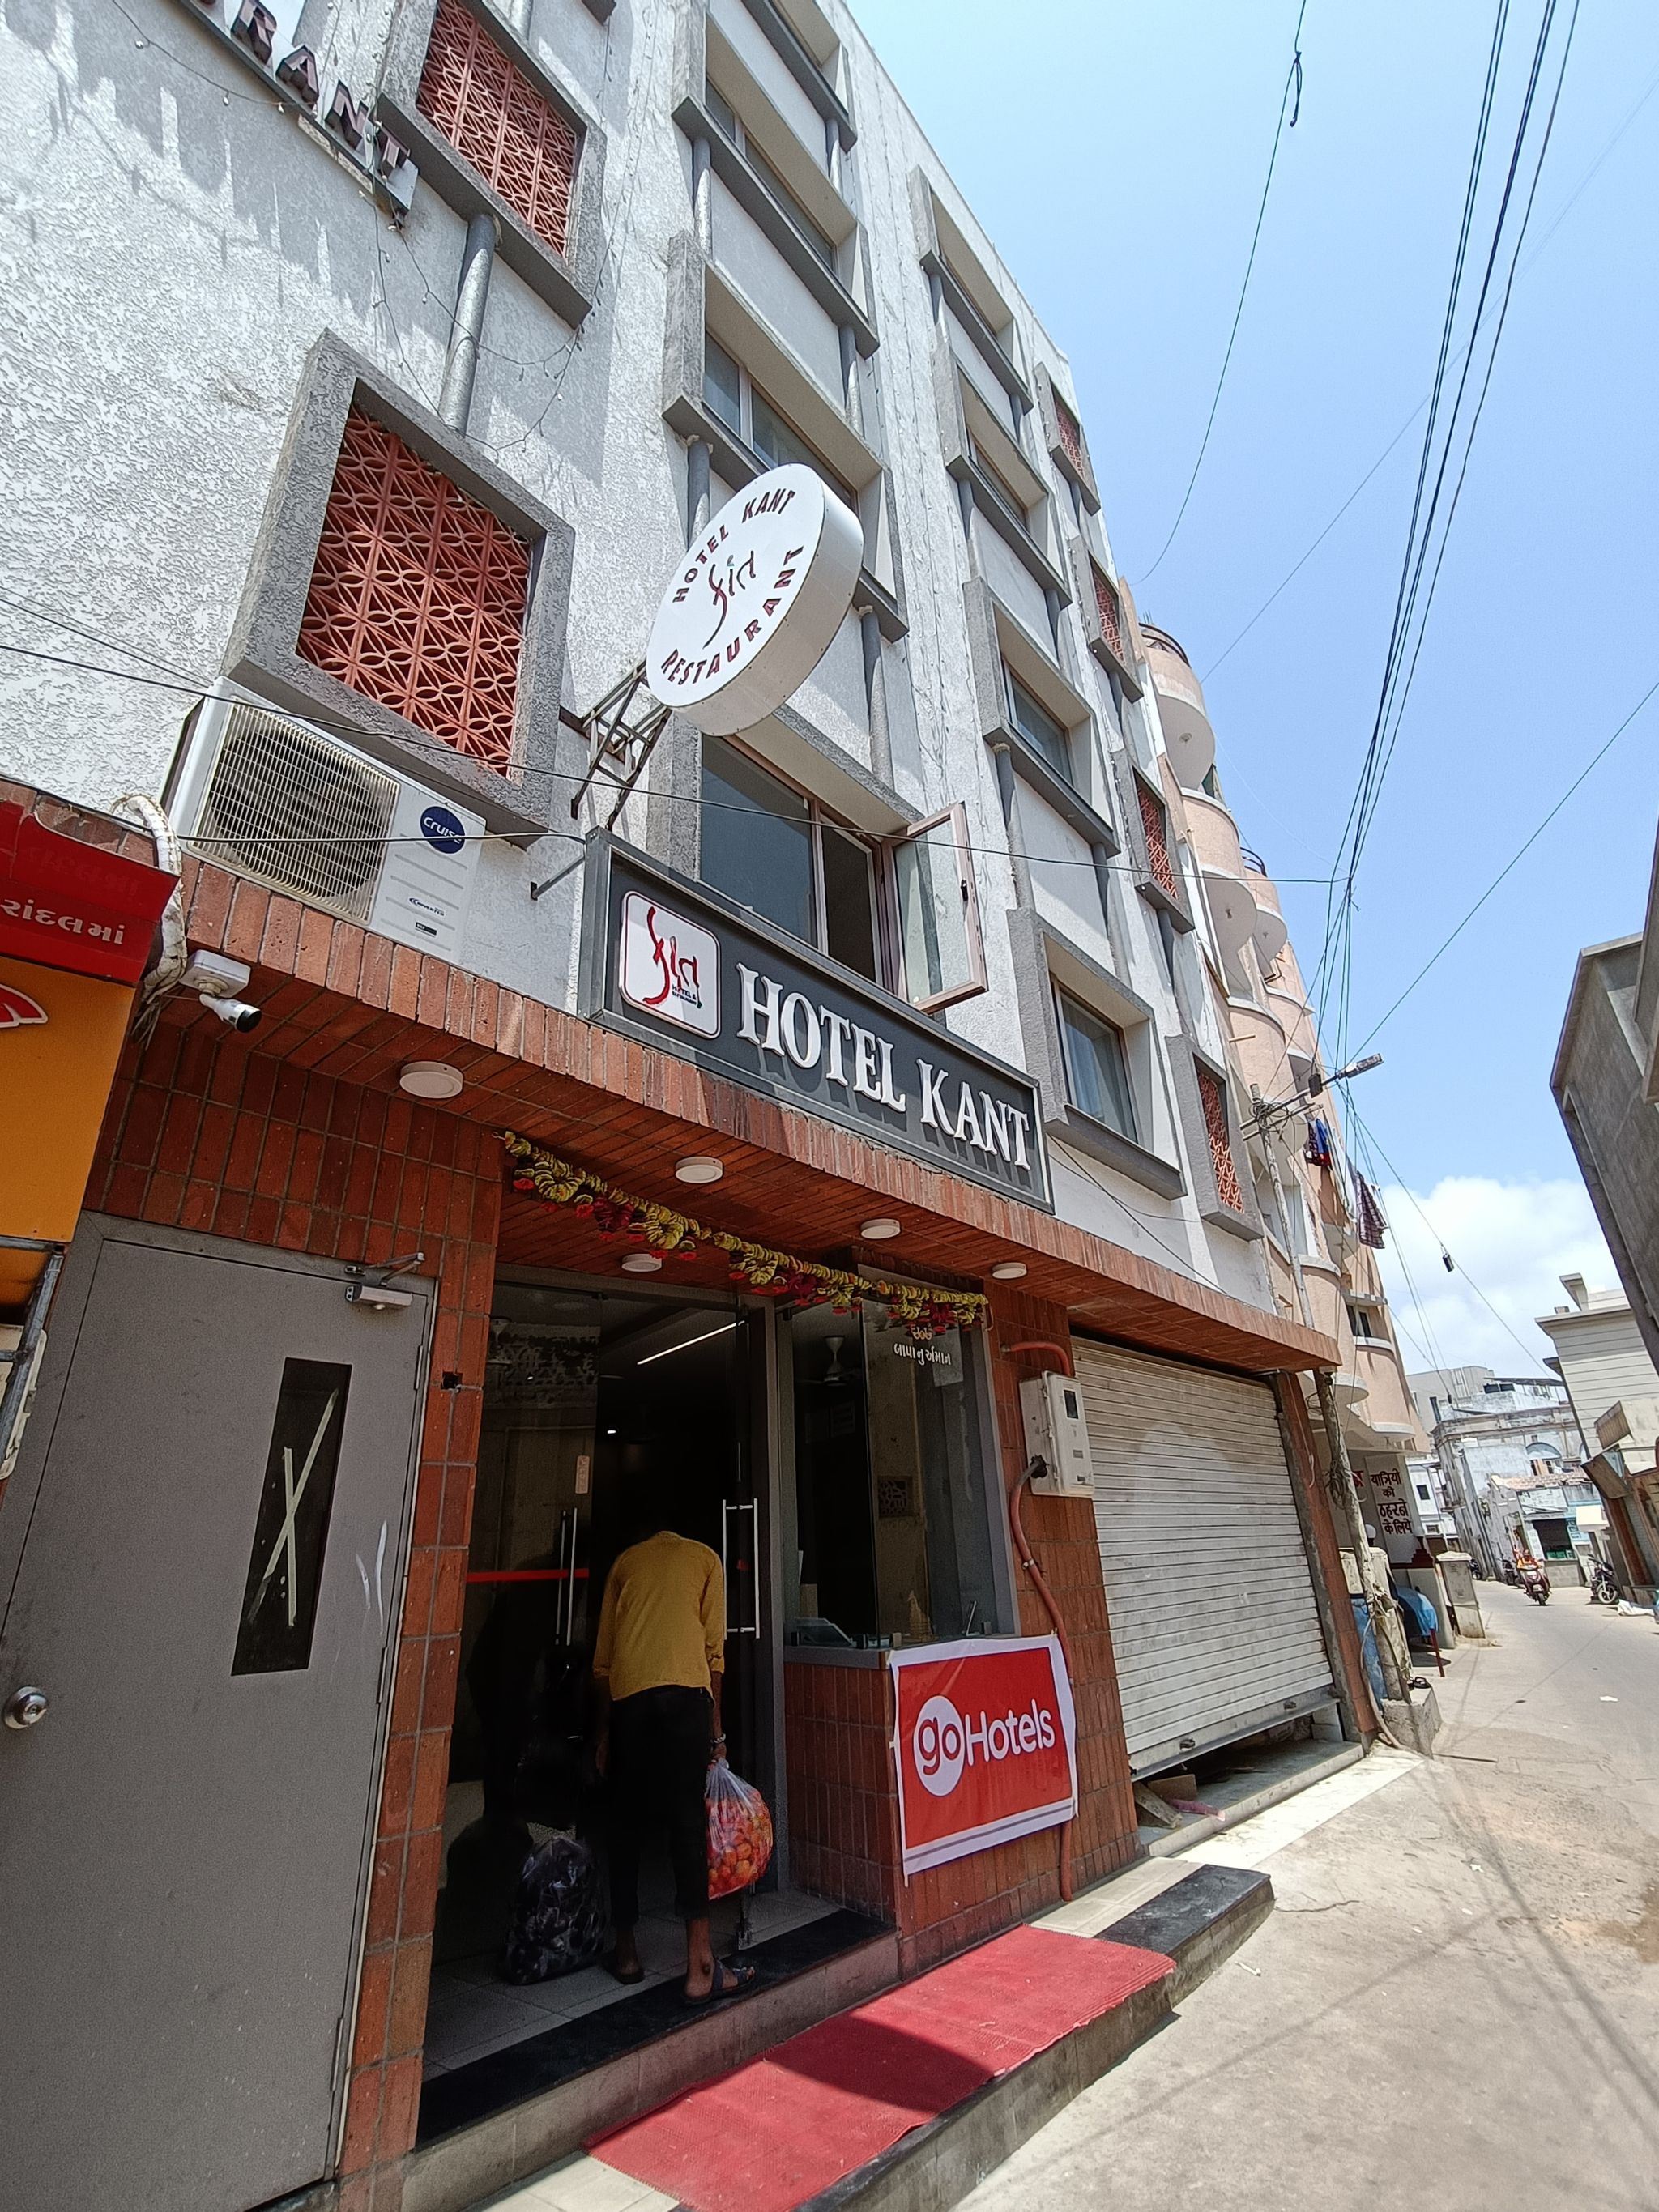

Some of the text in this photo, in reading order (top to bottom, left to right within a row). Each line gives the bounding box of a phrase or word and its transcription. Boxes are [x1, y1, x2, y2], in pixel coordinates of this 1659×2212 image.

[672, 488, 796, 603] HOTEL KANT
[661, 546, 804, 686] RESTAURANT
[736, 962, 1031, 1170] HOTEL KANT
[1377, 1498, 1409, 1519] ठहरने
